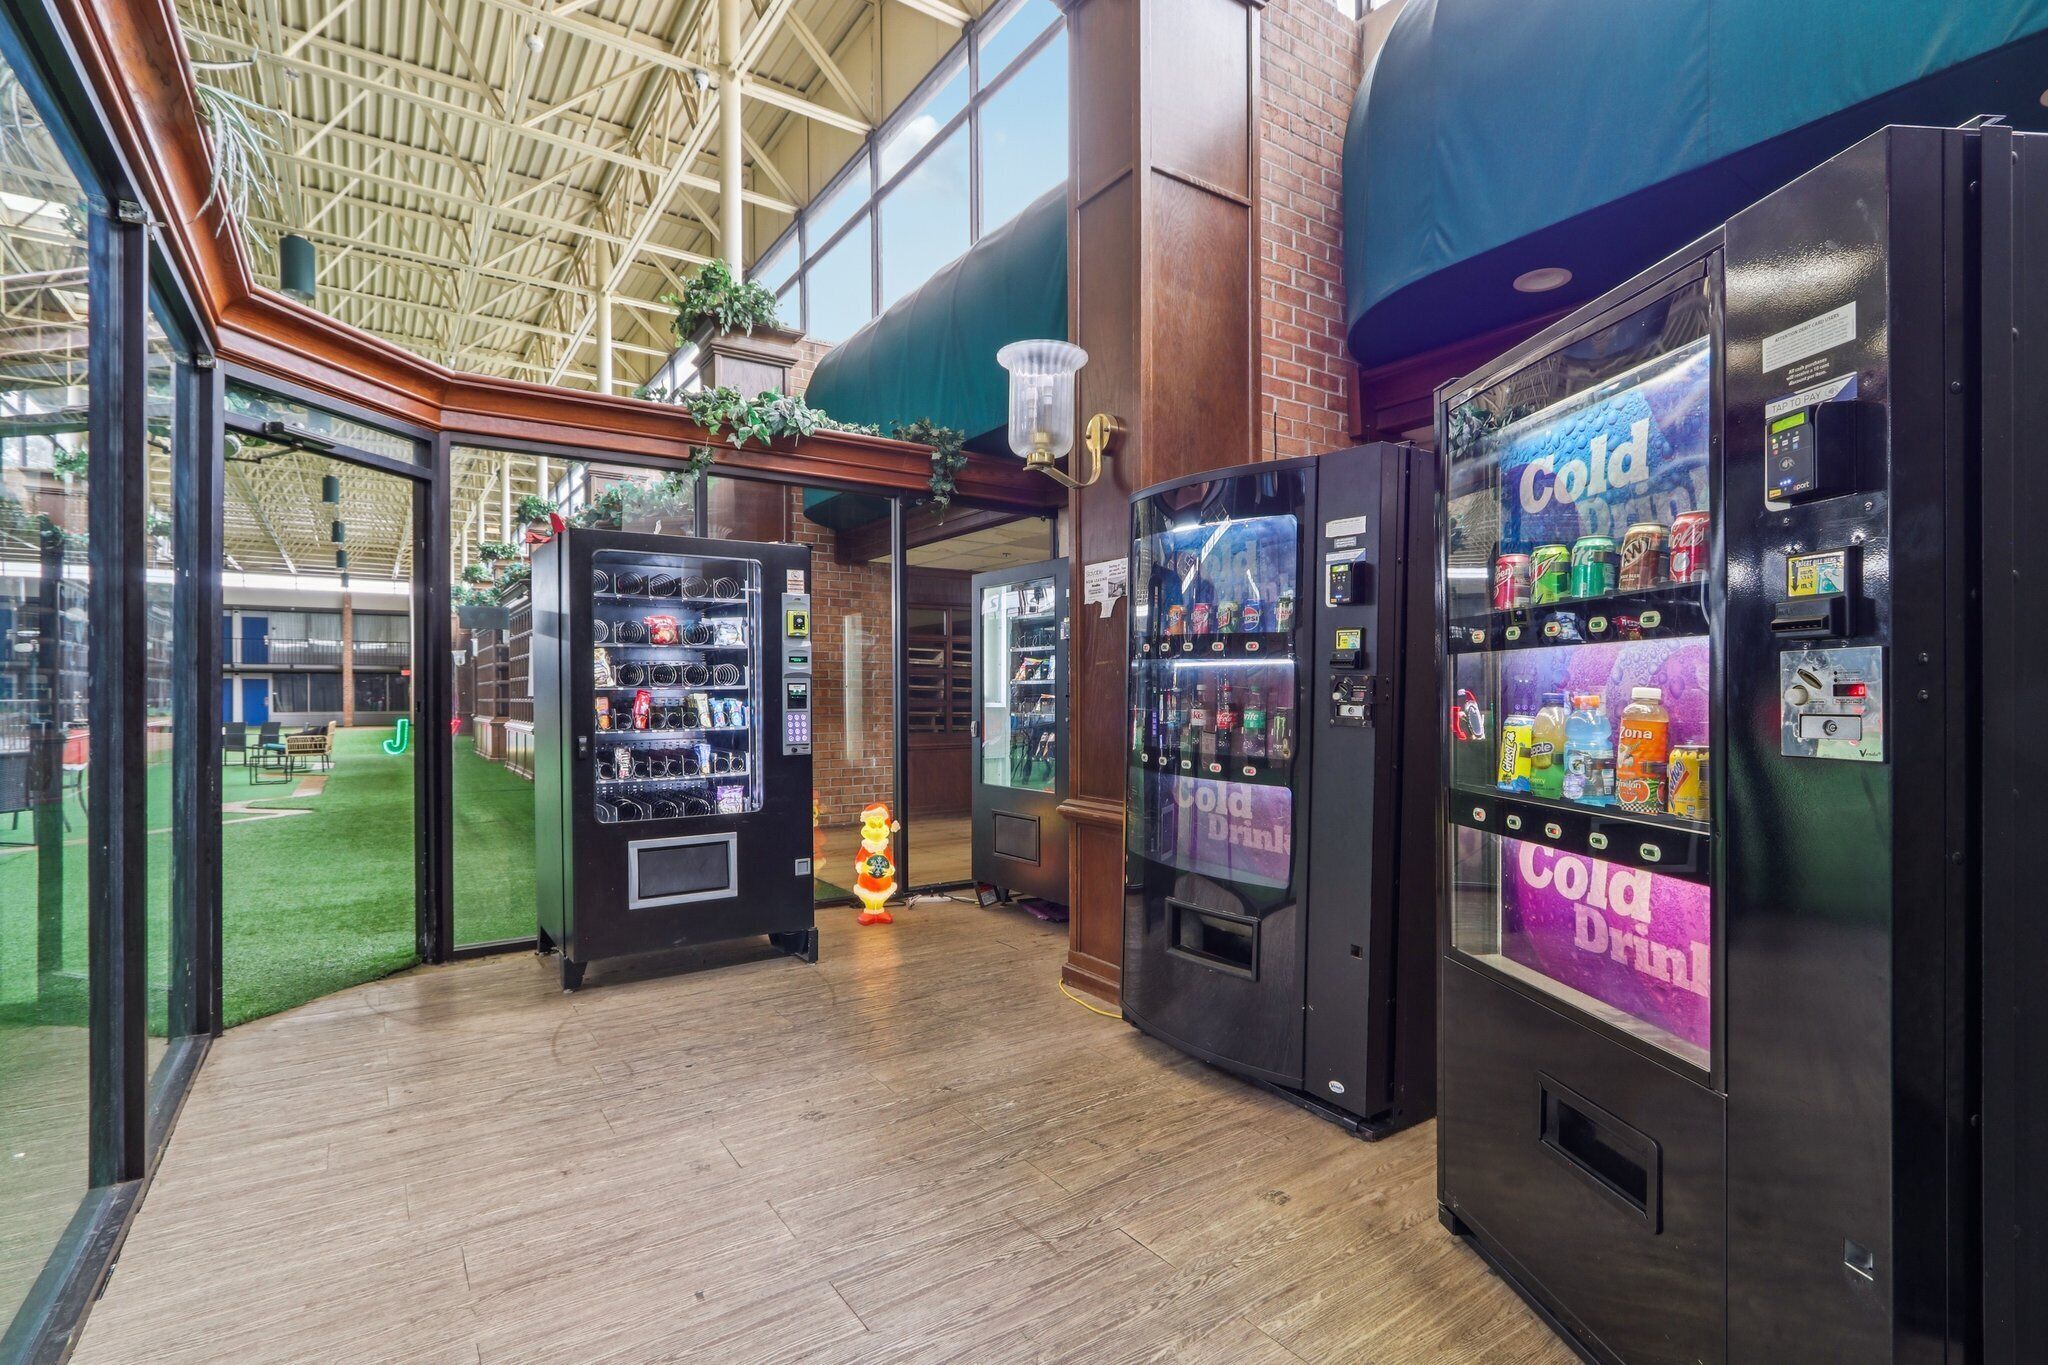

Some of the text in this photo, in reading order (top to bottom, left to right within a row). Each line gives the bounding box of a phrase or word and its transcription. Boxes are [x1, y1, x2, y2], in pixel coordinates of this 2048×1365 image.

[1775, 313, 1839, 342] ATTENTION DEBIT CARD USERS
[1772, 392, 1821, 414] TAP TO PAY
[1519, 418, 1650, 514] Cold
[1172, 776, 1253, 819] Cold
[1519, 840, 1652, 924] Cold
